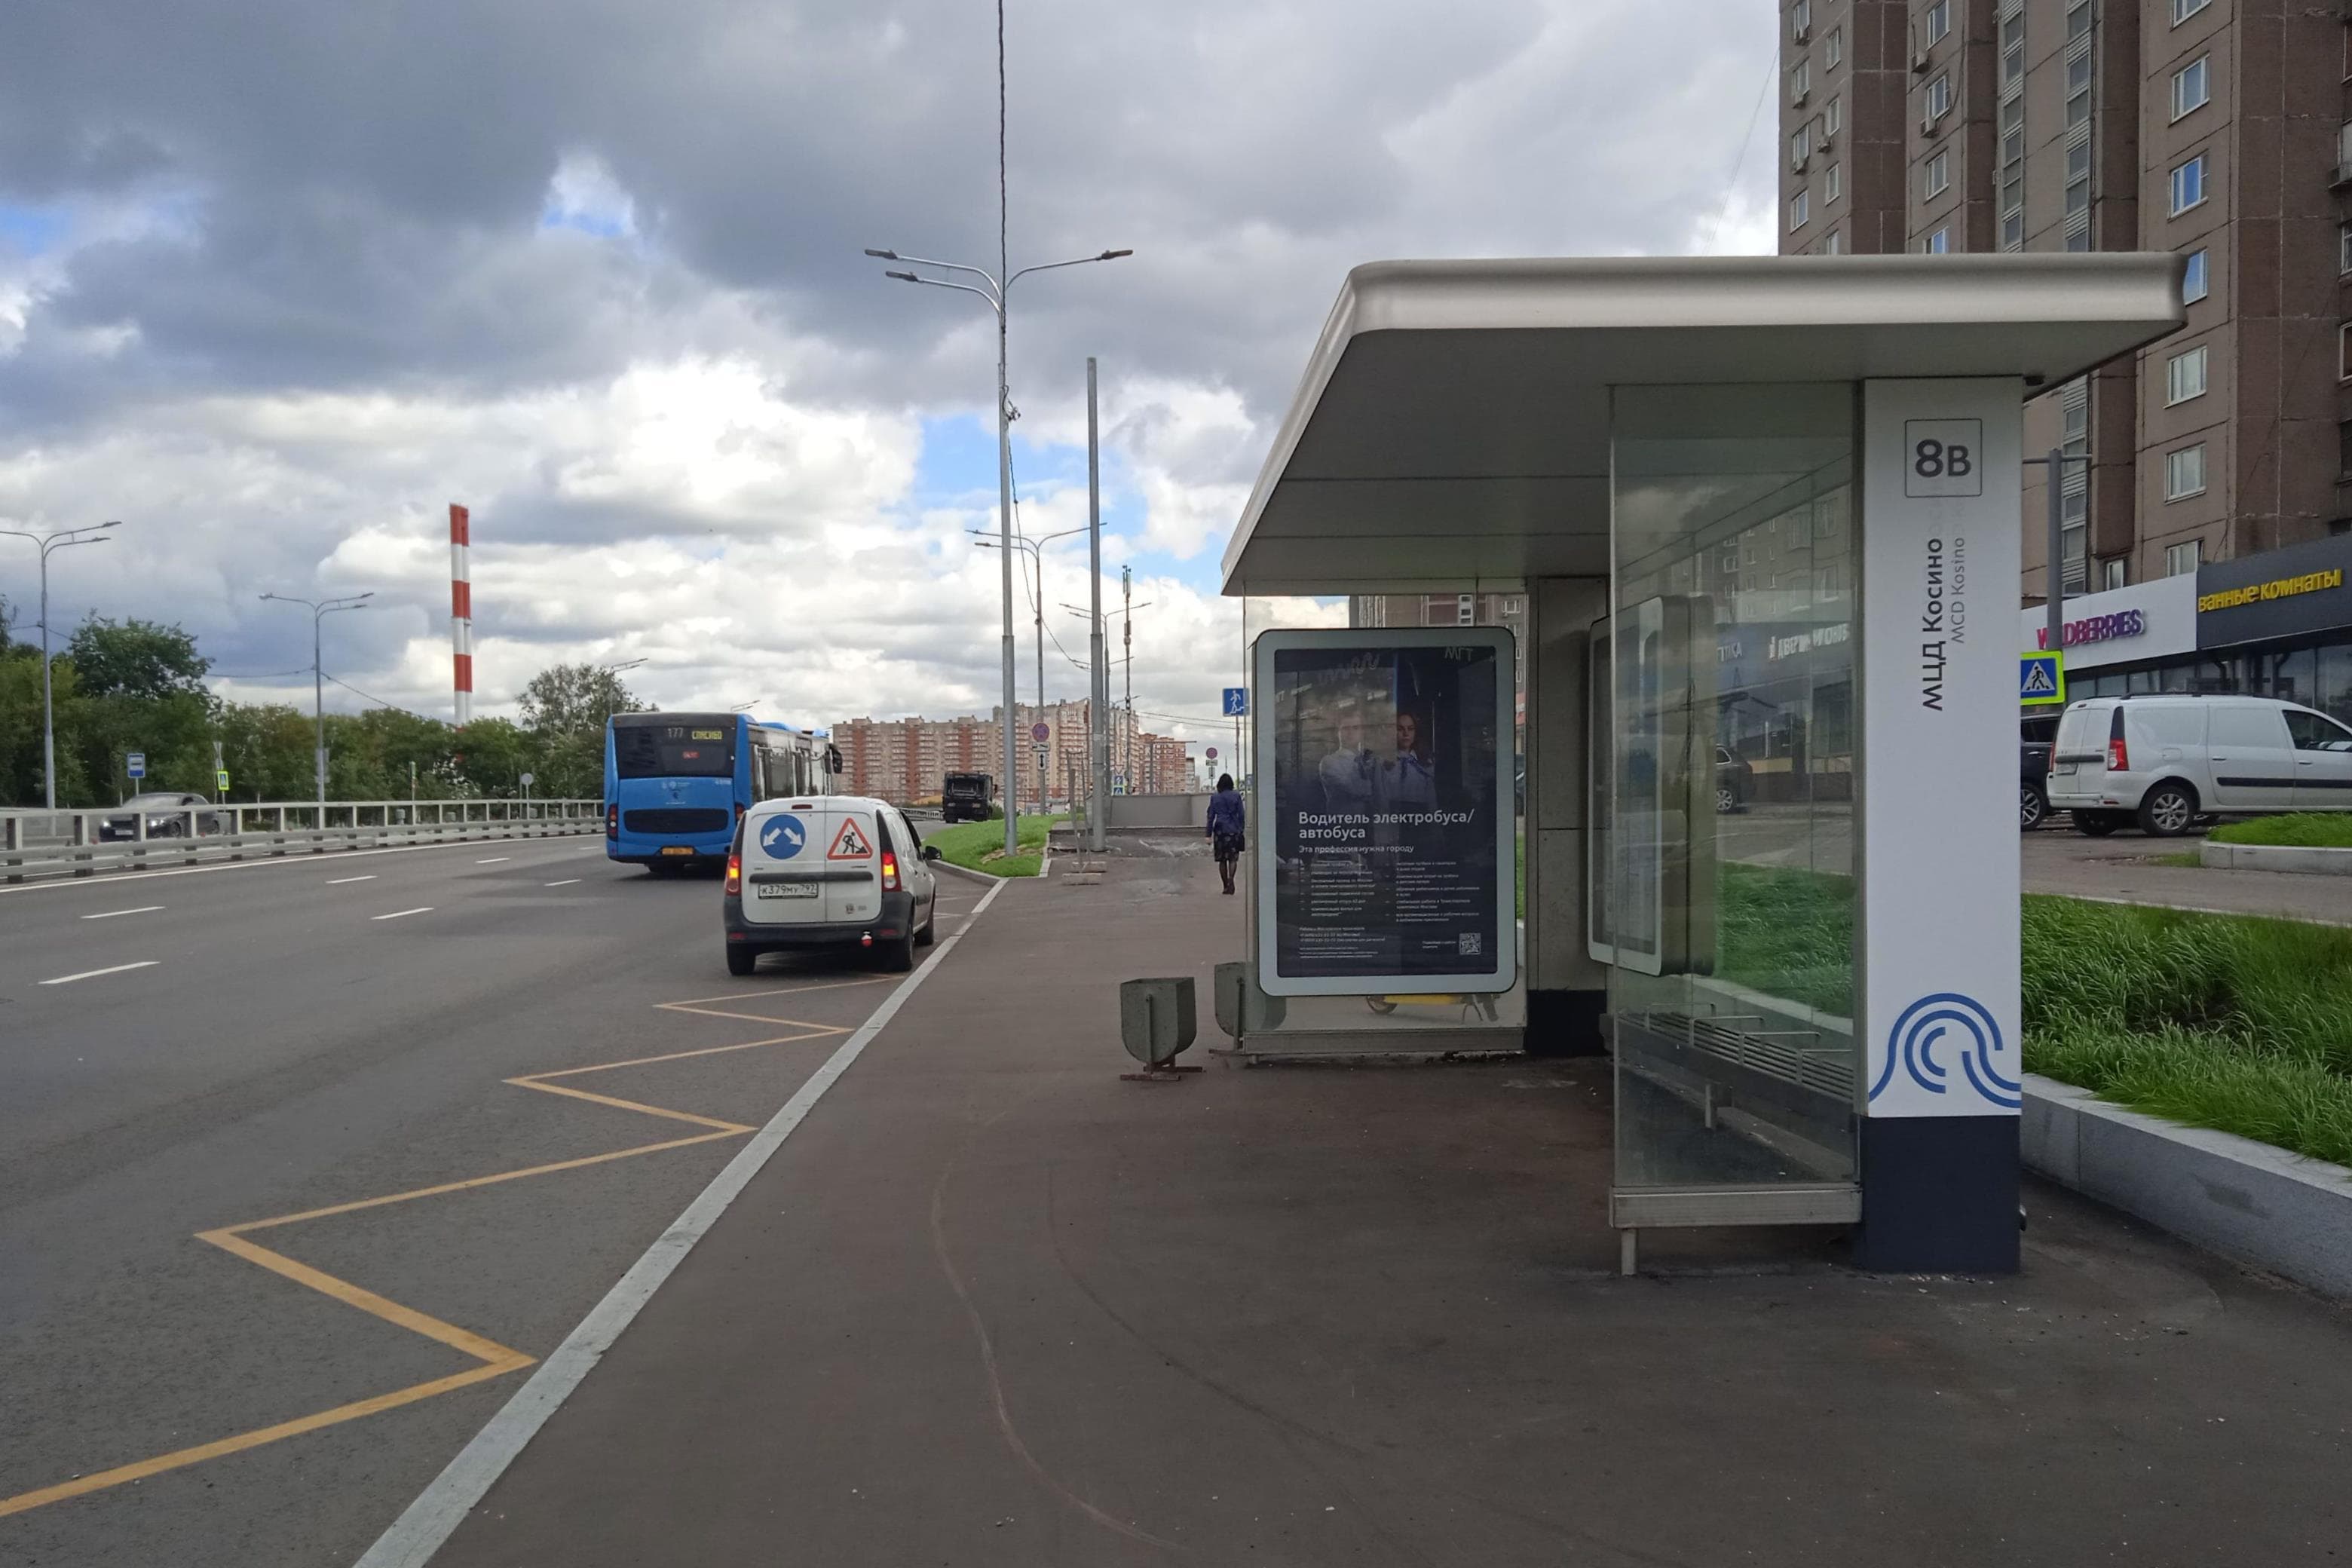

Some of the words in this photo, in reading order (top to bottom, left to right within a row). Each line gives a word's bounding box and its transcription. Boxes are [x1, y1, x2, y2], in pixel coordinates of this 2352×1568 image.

[1922, 538, 1943, 632] Косино
[1951, 537, 1965, 595] Kosino
[2198, 584, 2260, 612] ванные
[2260, 568, 2342, 601] комнаты
[1951, 601, 1965, 643] MCD
[2037, 609, 2142, 650] WDBERRIES
[1922, 641, 1946, 711] МЦД
[667, 727, 683, 737] 177
[1299, 812, 1369, 825] Водитель
[1374, 809, 1475, 825] электробуса/
[1299, 826, 1366, 841] автобуса
[1315, 844, 1358, 853] профессия
[1359, 846, 1385, 854] нужна
[1386, 845, 1414, 853] городу
